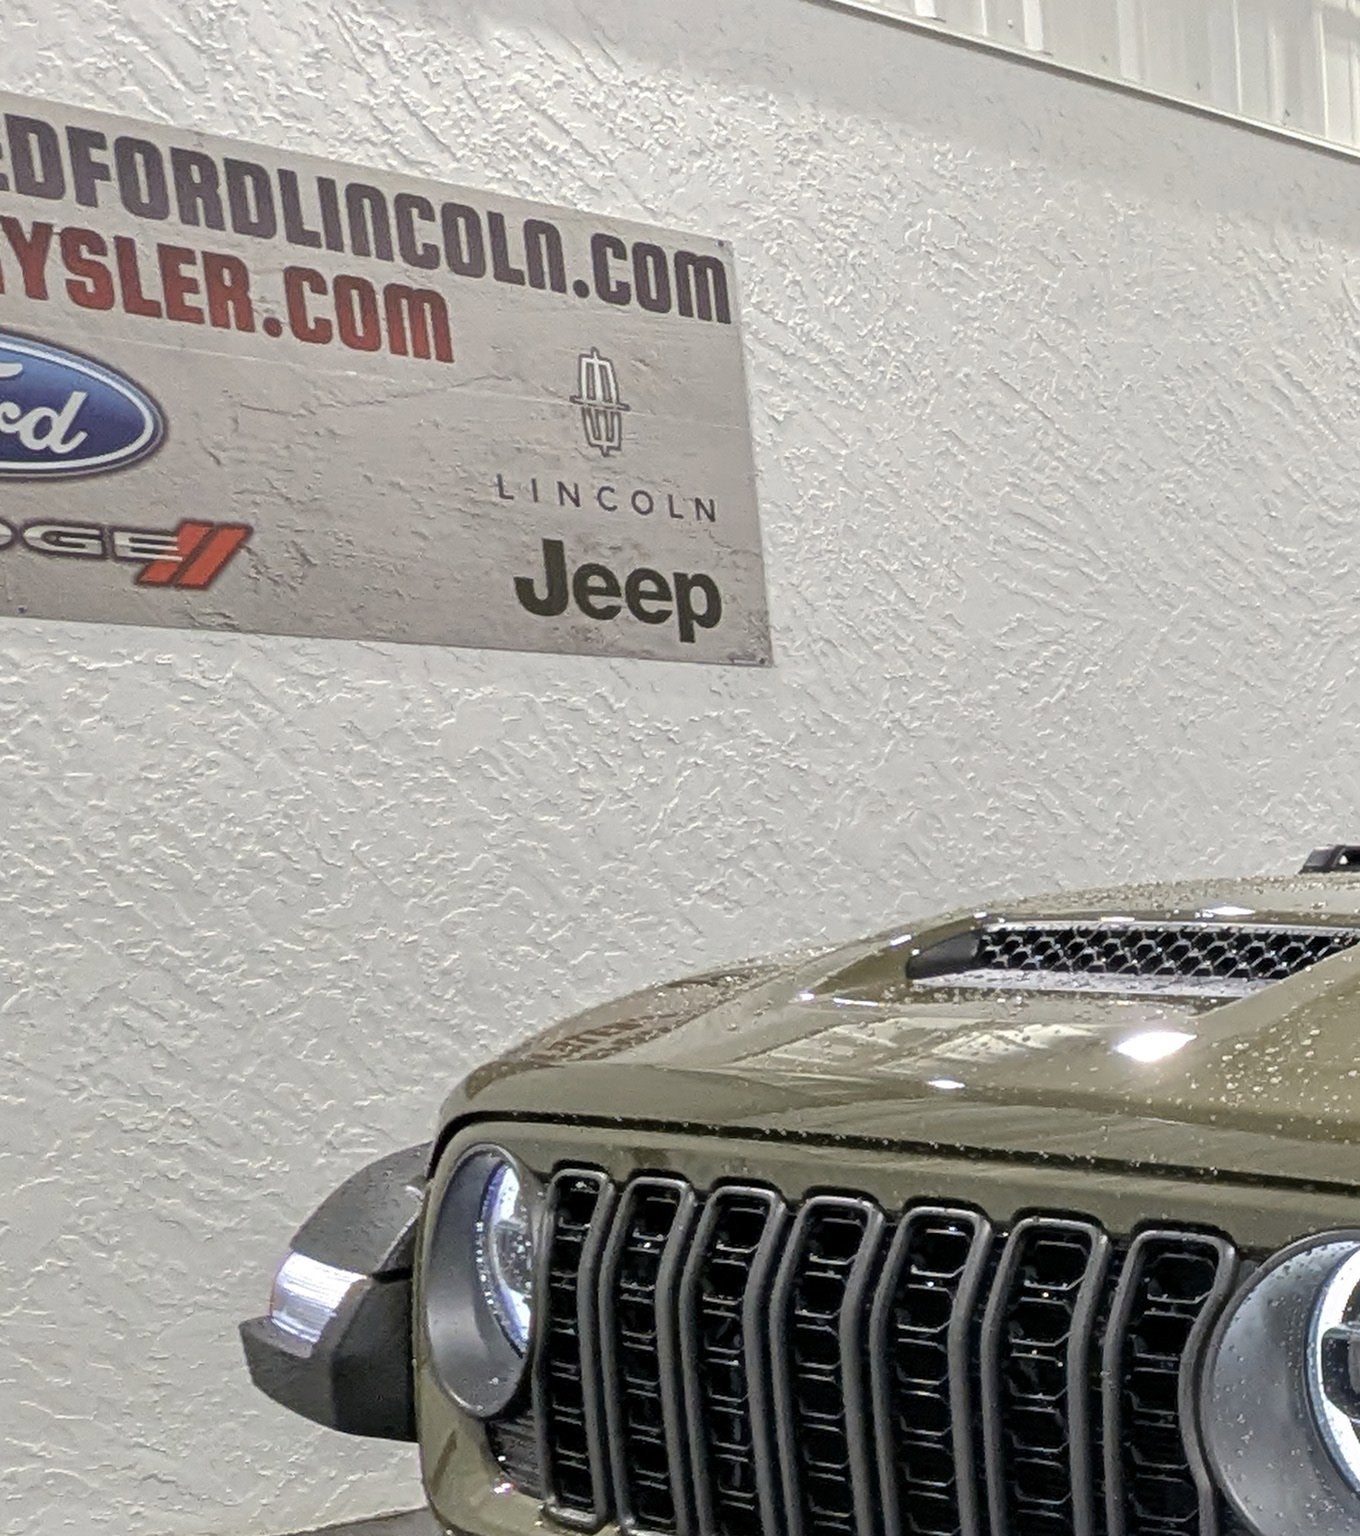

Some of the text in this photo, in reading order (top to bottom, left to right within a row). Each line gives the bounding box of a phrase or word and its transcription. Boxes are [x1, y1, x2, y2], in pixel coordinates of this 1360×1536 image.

[0, 113, 732, 324] DFORDLINCOLN.COM
[0, 214, 455, 364] YSLER.COM
[497, 474, 718, 524] LINCOLN
[514, 539, 722, 643] Jeep
